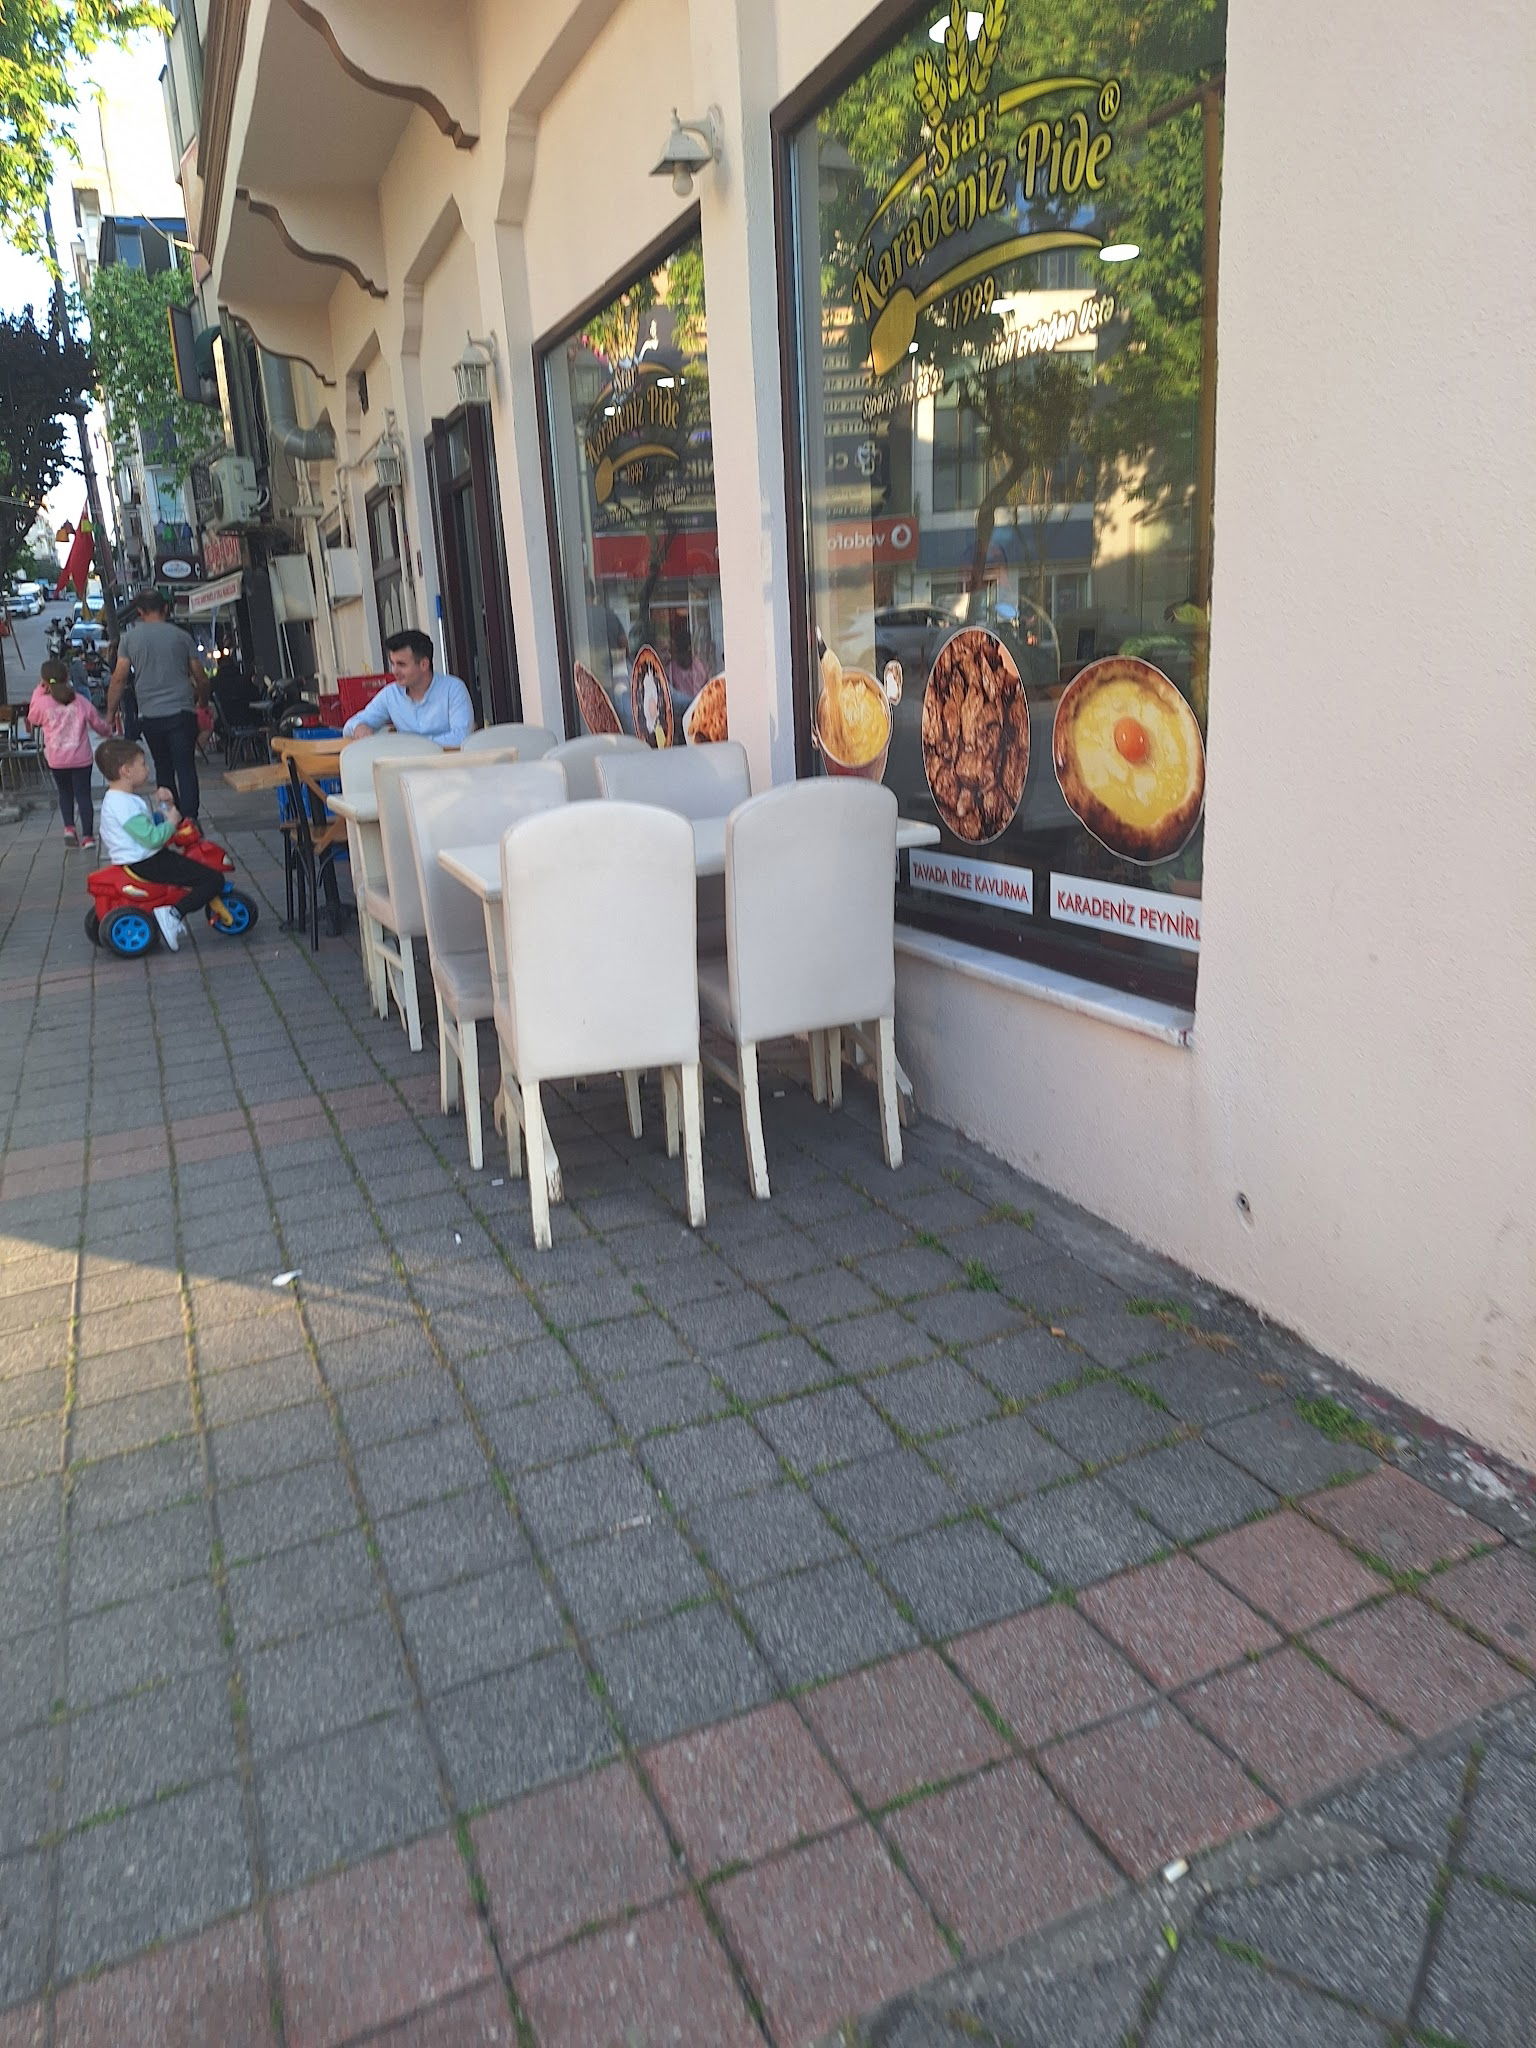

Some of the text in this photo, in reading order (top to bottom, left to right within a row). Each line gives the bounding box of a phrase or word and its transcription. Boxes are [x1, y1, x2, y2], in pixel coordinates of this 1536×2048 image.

[933, 104, 990, 177] Star
[852, 154, 1008, 320] Karadeniz
[1018, 113, 1113, 200] Pide
[951, 276, 996, 331] 1999
[1077, 294, 1116, 335] Usta
[612, 365, 638, 396] Star
[646, 384, 680, 430] Pide
[912, 862, 1029, 903] TAVADA RİZE KAVURMA
[1056, 888, 1136, 926] KARADENİZ
